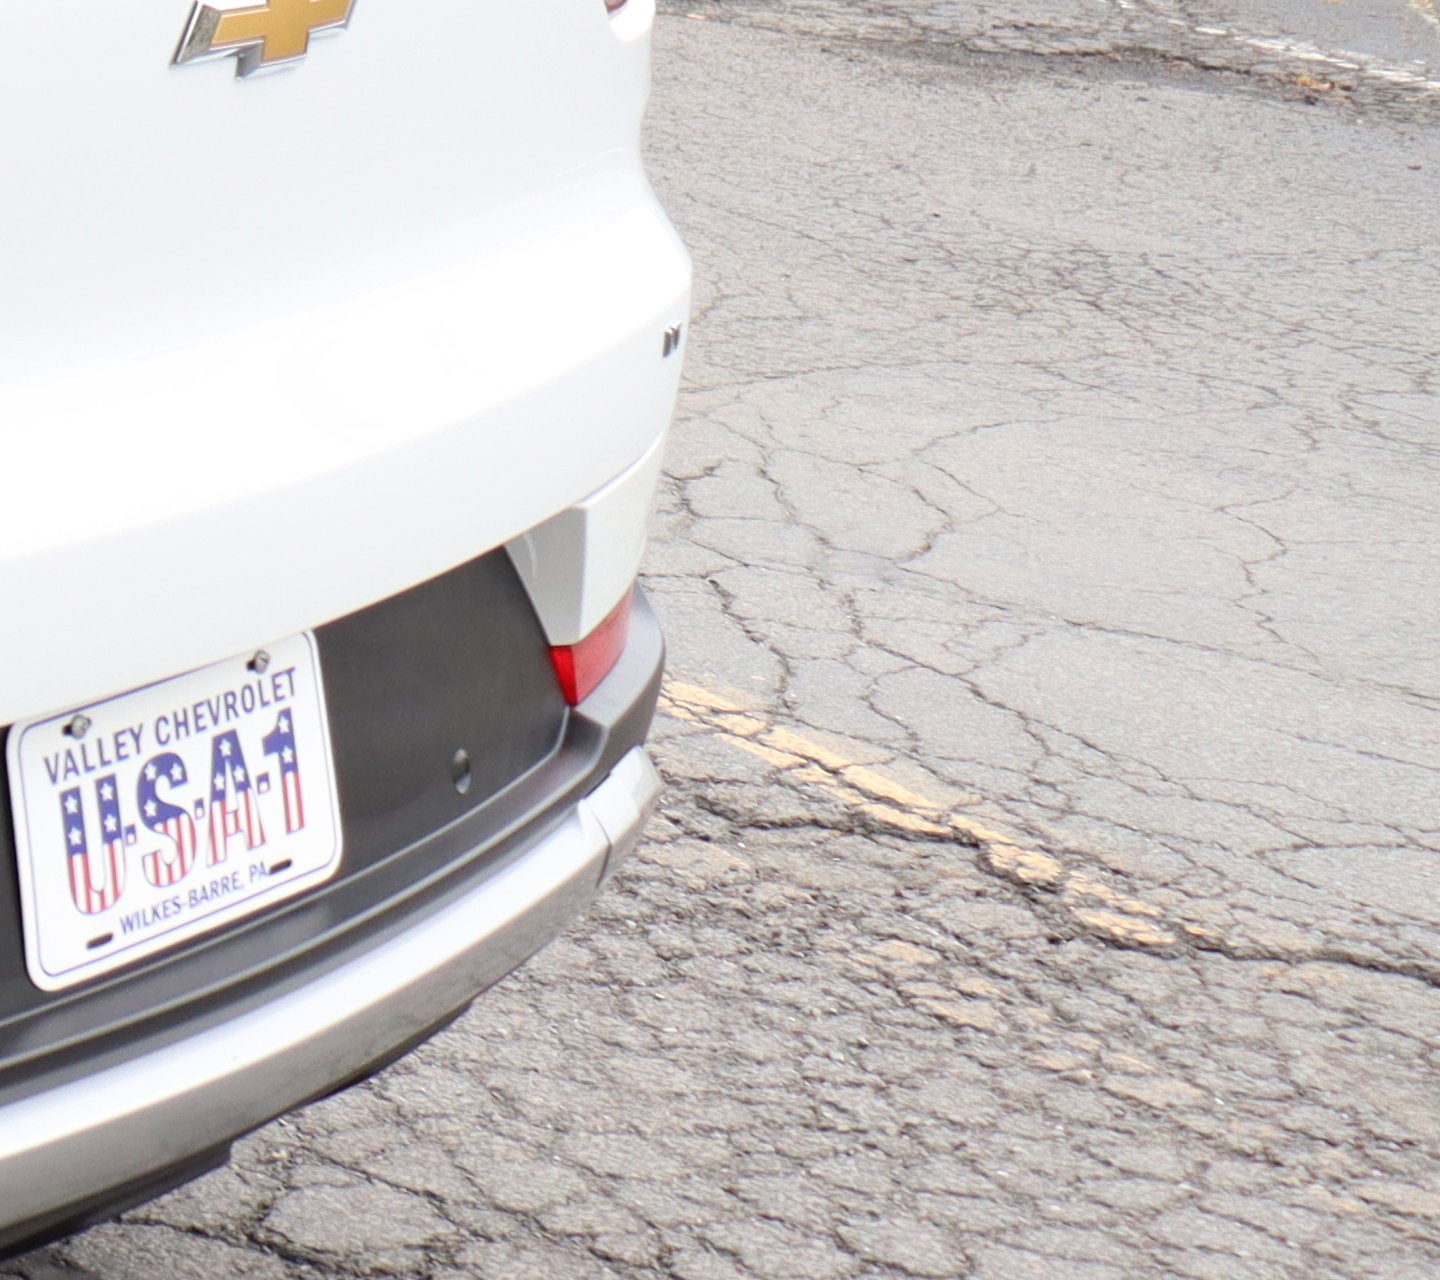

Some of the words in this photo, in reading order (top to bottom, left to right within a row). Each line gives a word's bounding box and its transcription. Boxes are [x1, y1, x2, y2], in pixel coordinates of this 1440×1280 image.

[44, 723, 146, 786] VALLEY
[154, 666, 297, 747] CHEVROLET
[119, 871, 246, 936] WILKES-BARRE,
